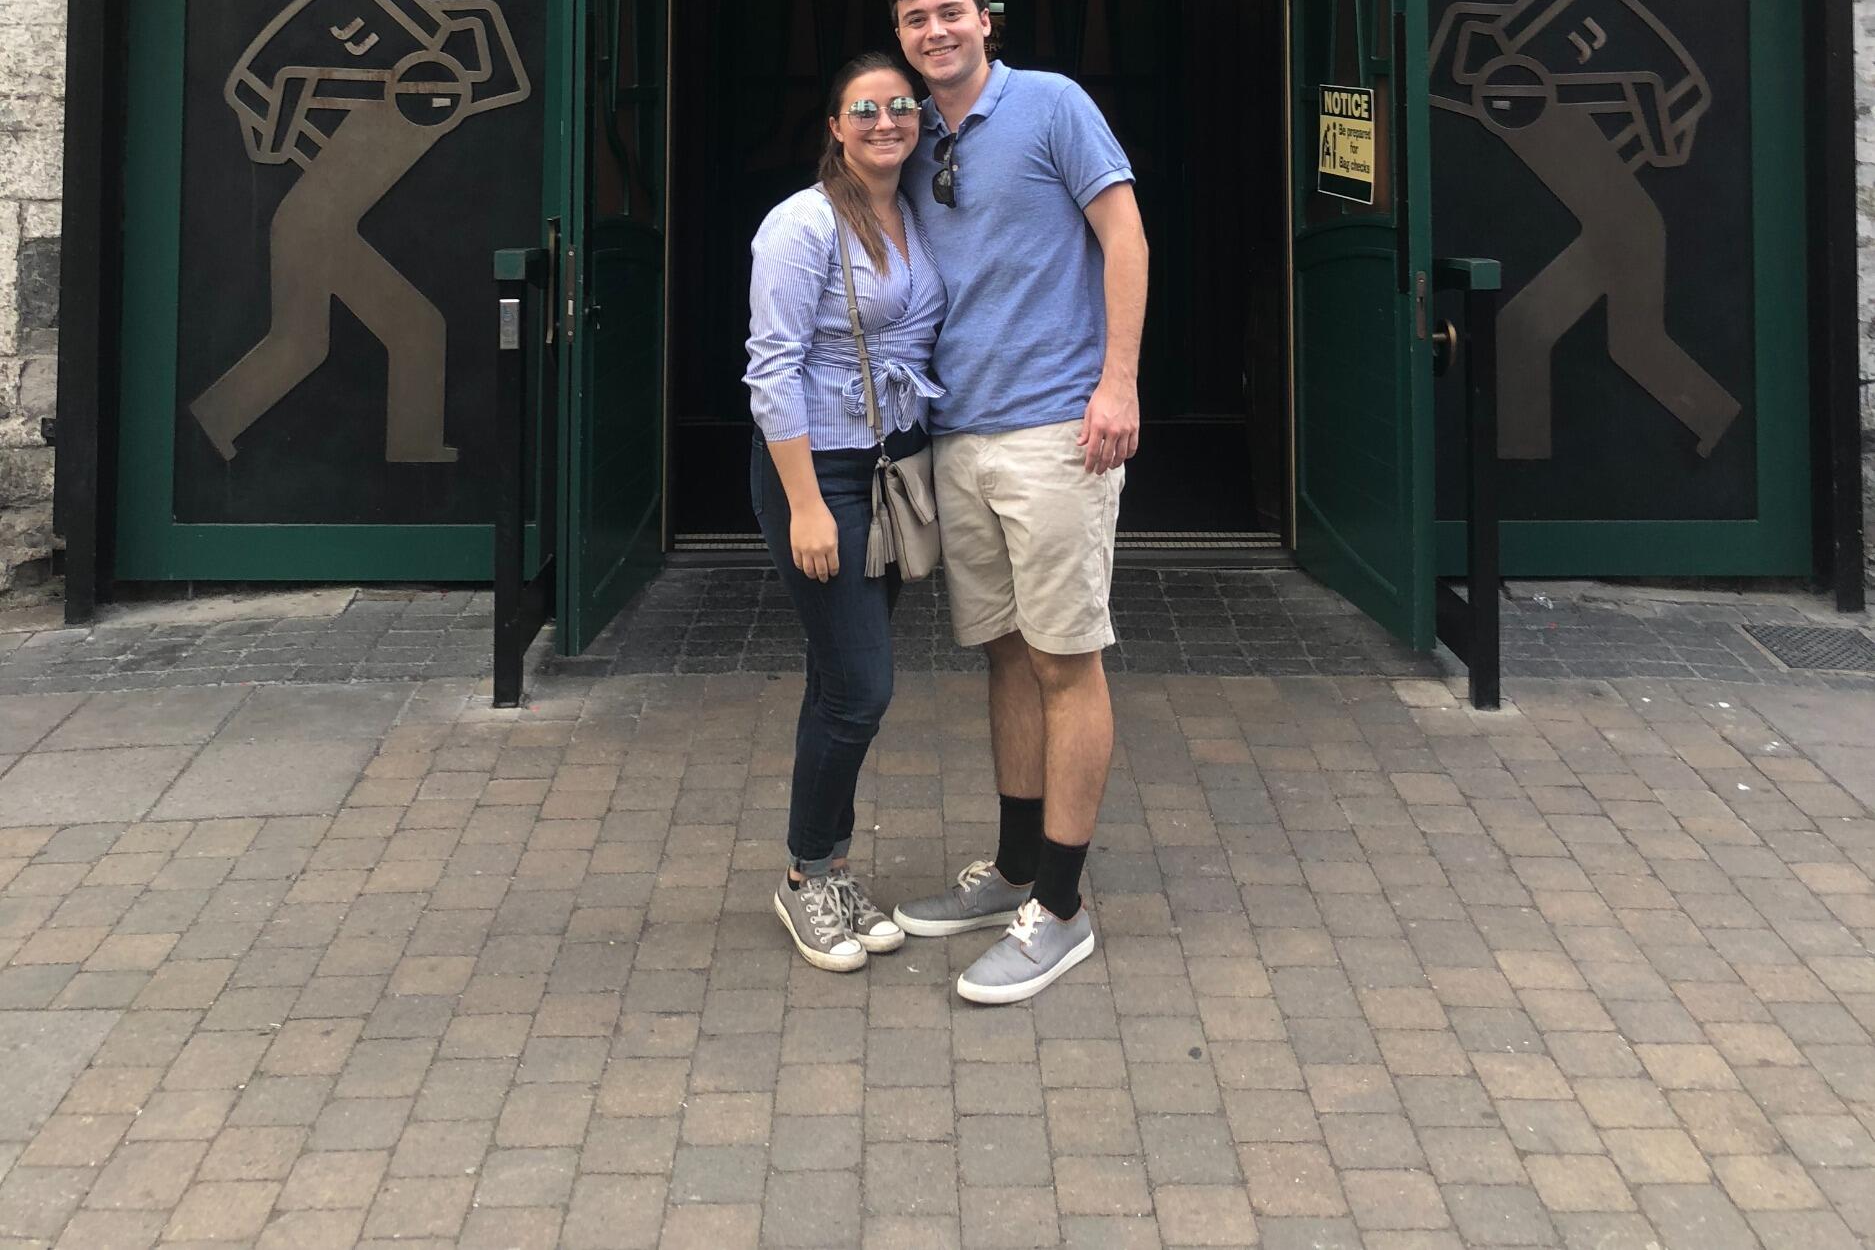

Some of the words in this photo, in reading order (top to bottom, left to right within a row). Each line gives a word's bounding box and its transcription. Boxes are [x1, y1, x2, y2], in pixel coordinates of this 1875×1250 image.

[1323, 91, 1370, 118] NOTICE
[1338, 123, 1346, 136] Be
[1346, 127, 1372, 141] prepared
[1350, 141, 1359, 154] for
[1339, 155, 1350, 173] Bag
[1351, 159, 1370, 174] checks
